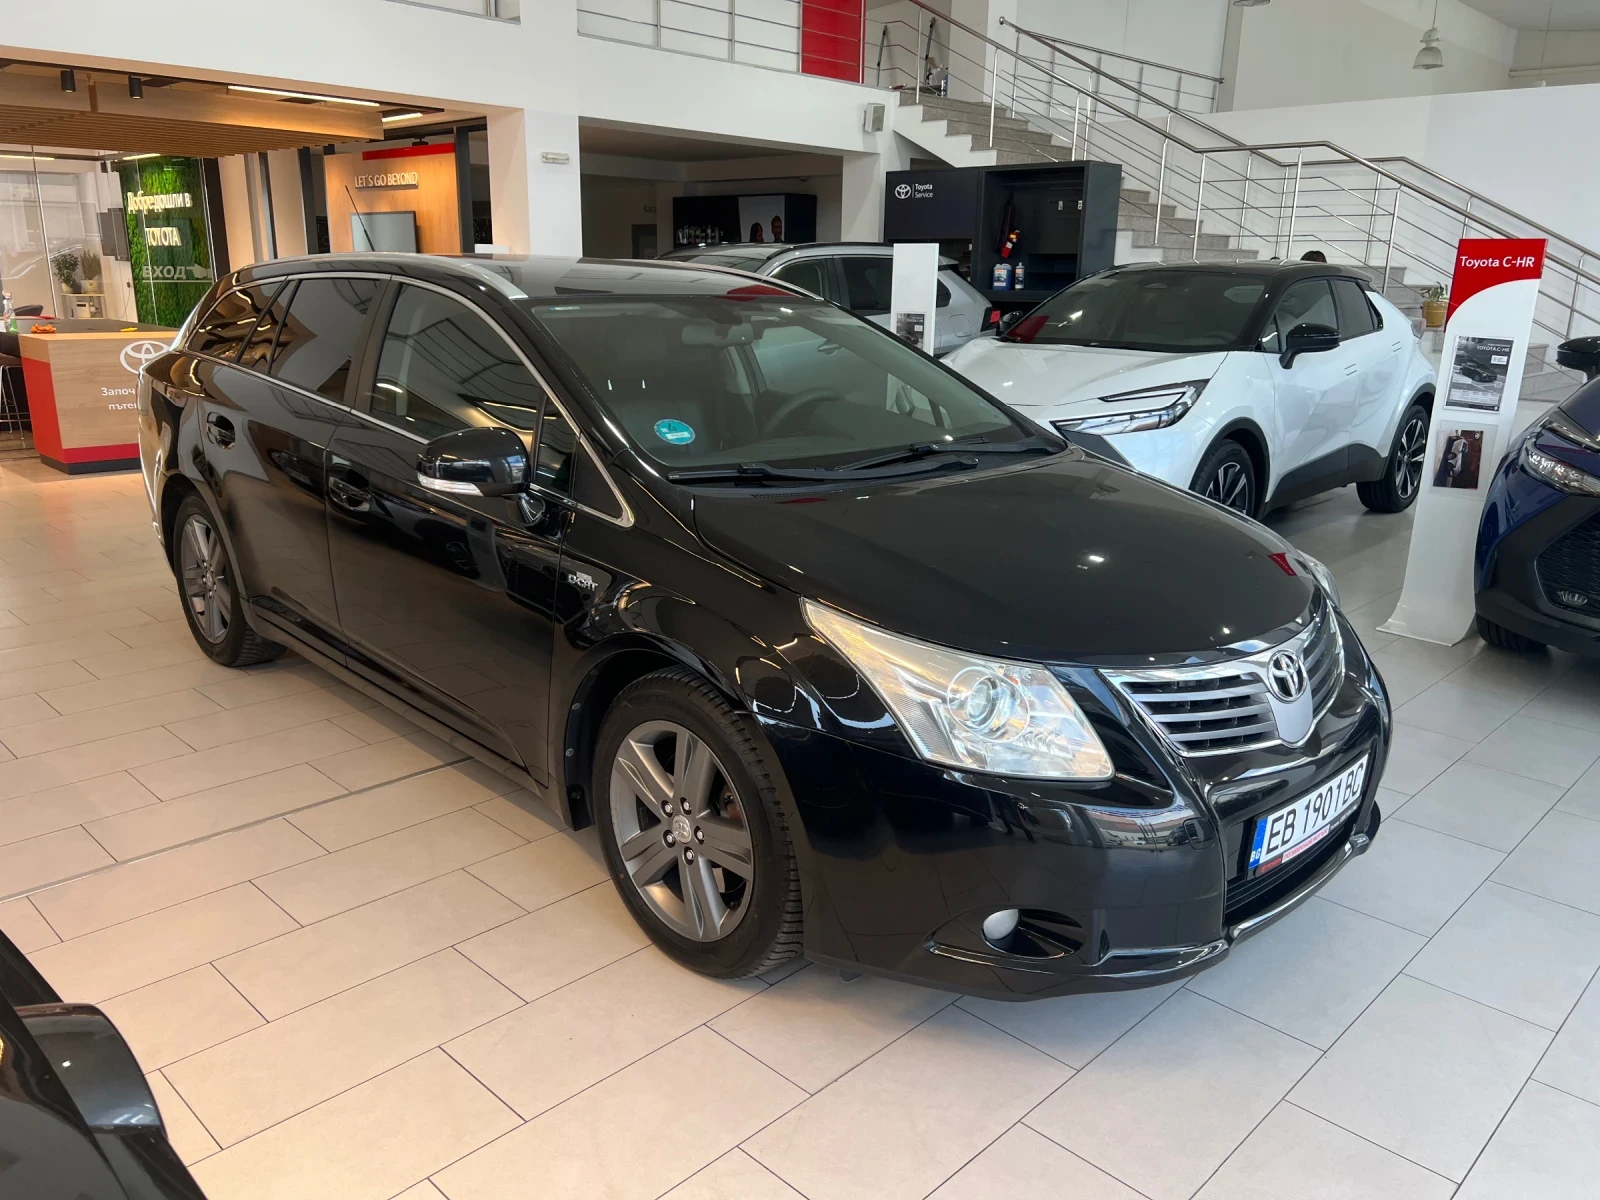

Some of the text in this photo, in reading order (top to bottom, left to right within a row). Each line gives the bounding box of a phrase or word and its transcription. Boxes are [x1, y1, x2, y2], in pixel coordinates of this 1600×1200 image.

[374, 174, 386, 187] GO
[387, 172, 418, 186] BEYOND
[915, 183, 932, 191] Toyota
[145, 227, 182, 247] TOYOTA
[1460, 256, 1535, 269] Toyota C-HR
[142, 265, 187, 280] ВХОД
[101, 387, 136, 396] Започ
[1265, 808, 1297, 856] EB
[1250, 848, 1262, 862] BG
